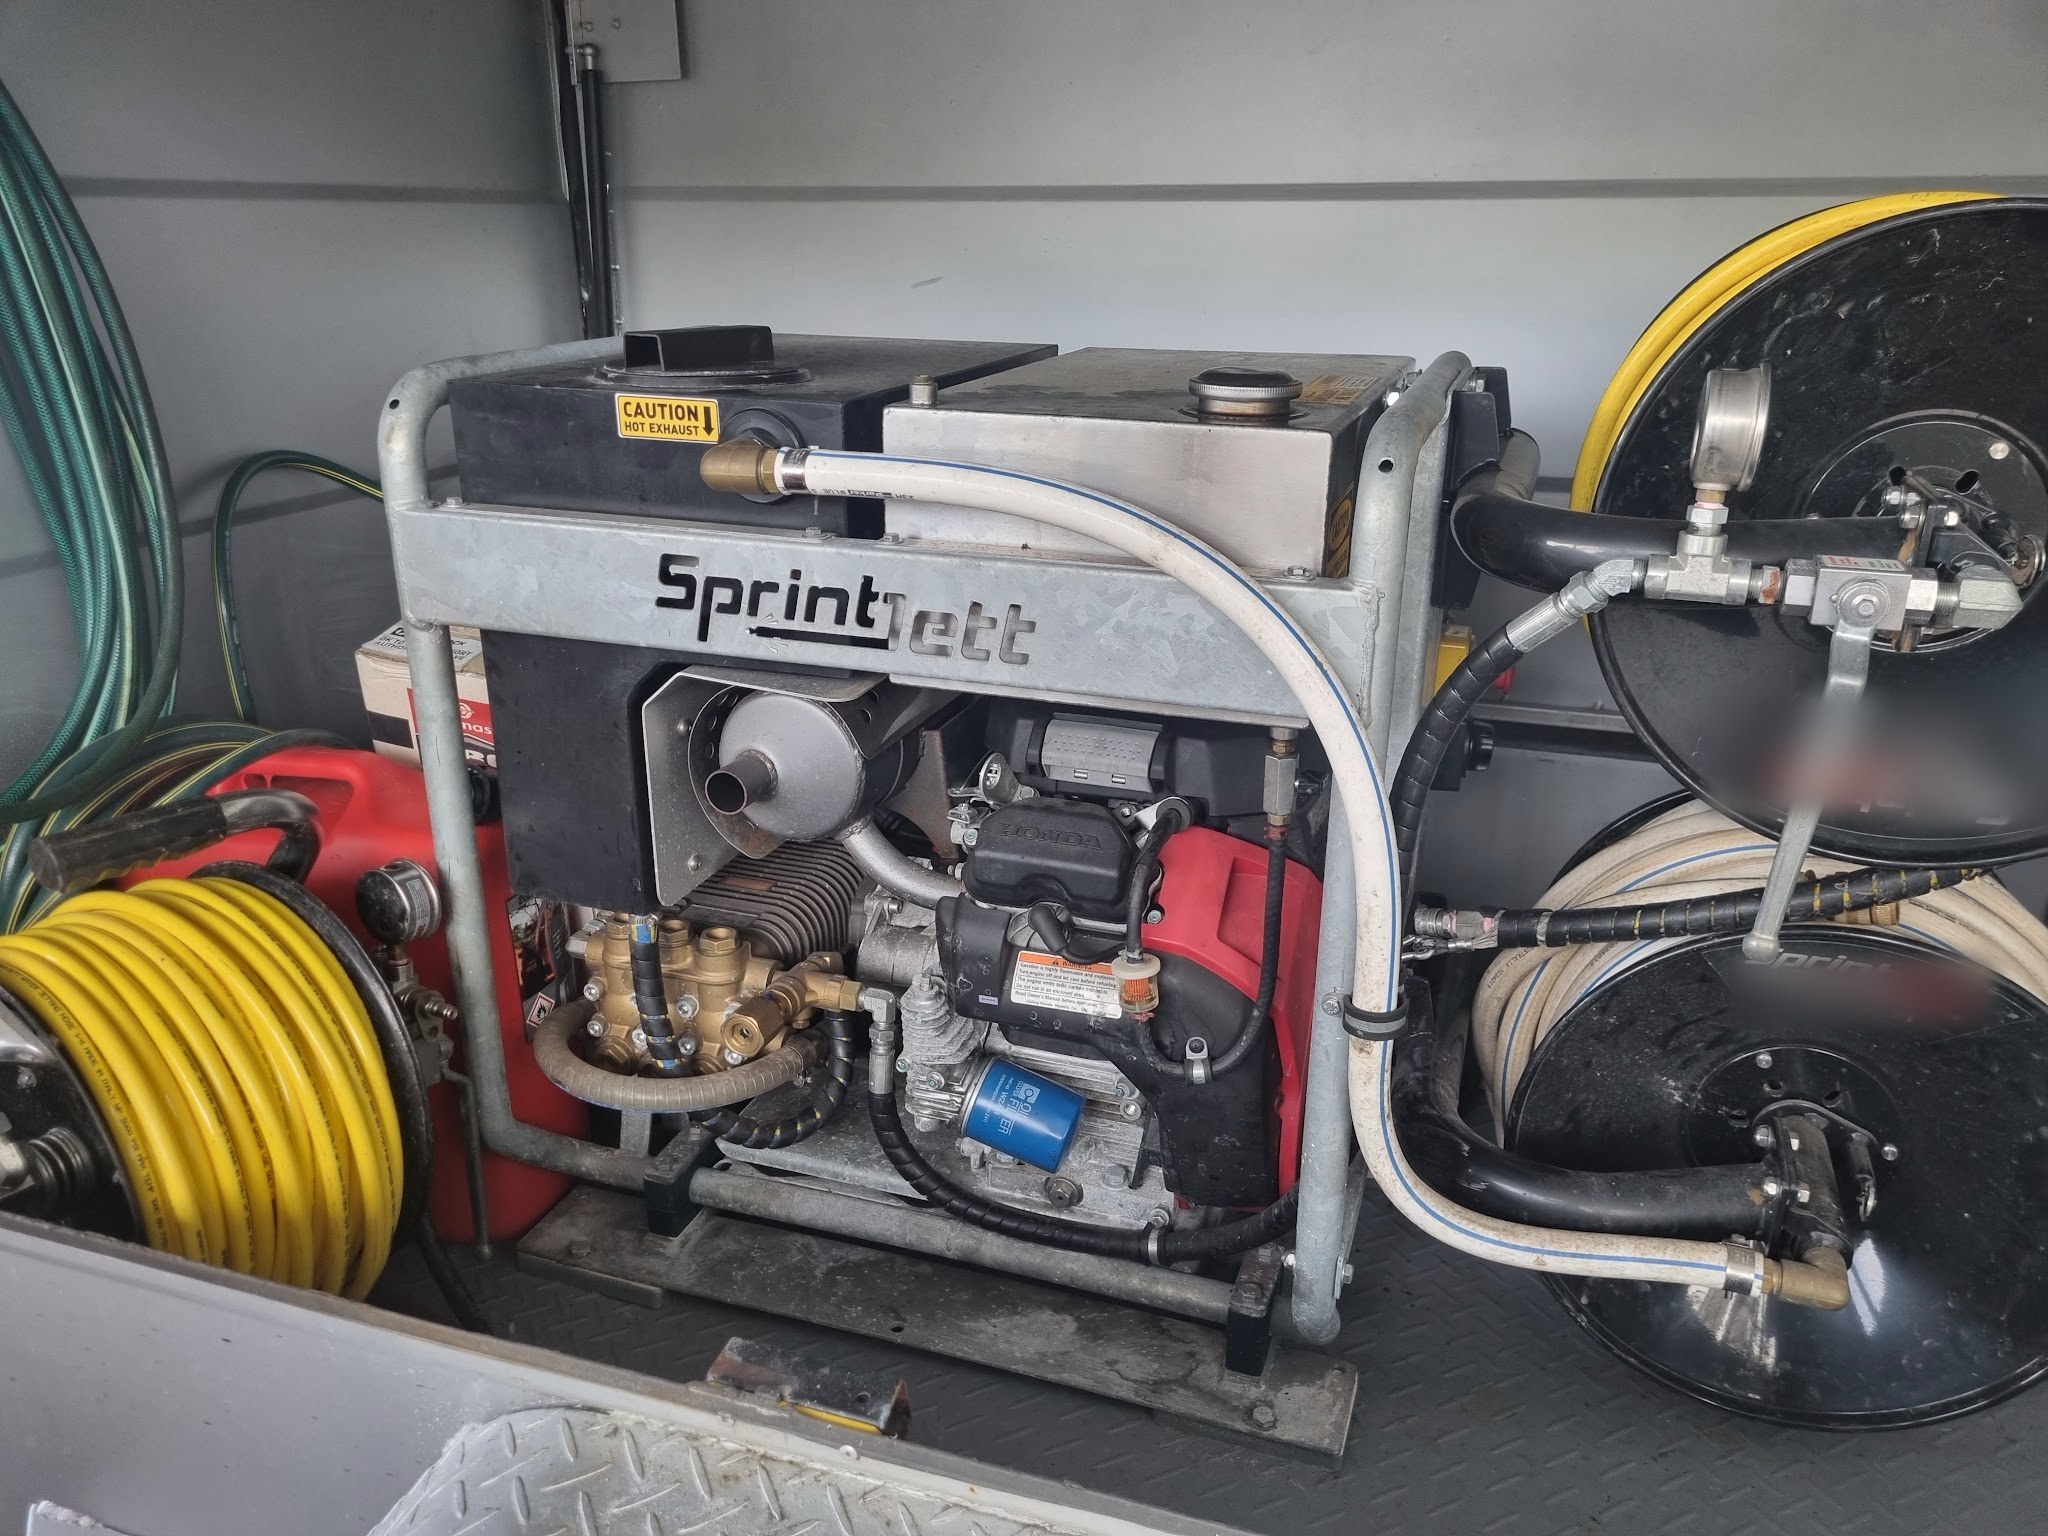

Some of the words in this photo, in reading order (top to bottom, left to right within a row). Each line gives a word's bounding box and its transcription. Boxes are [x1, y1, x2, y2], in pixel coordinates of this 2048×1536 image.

[623, 401, 699, 422] CAUTION
[624, 421, 646, 432] HOT
[649, 423, 700, 436] EXHAUST
[1000, 822, 1104, 850] HONDA
[1060, 968, 1083, 976] flammable
[1018, 1102, 1032, 1120] OIL
